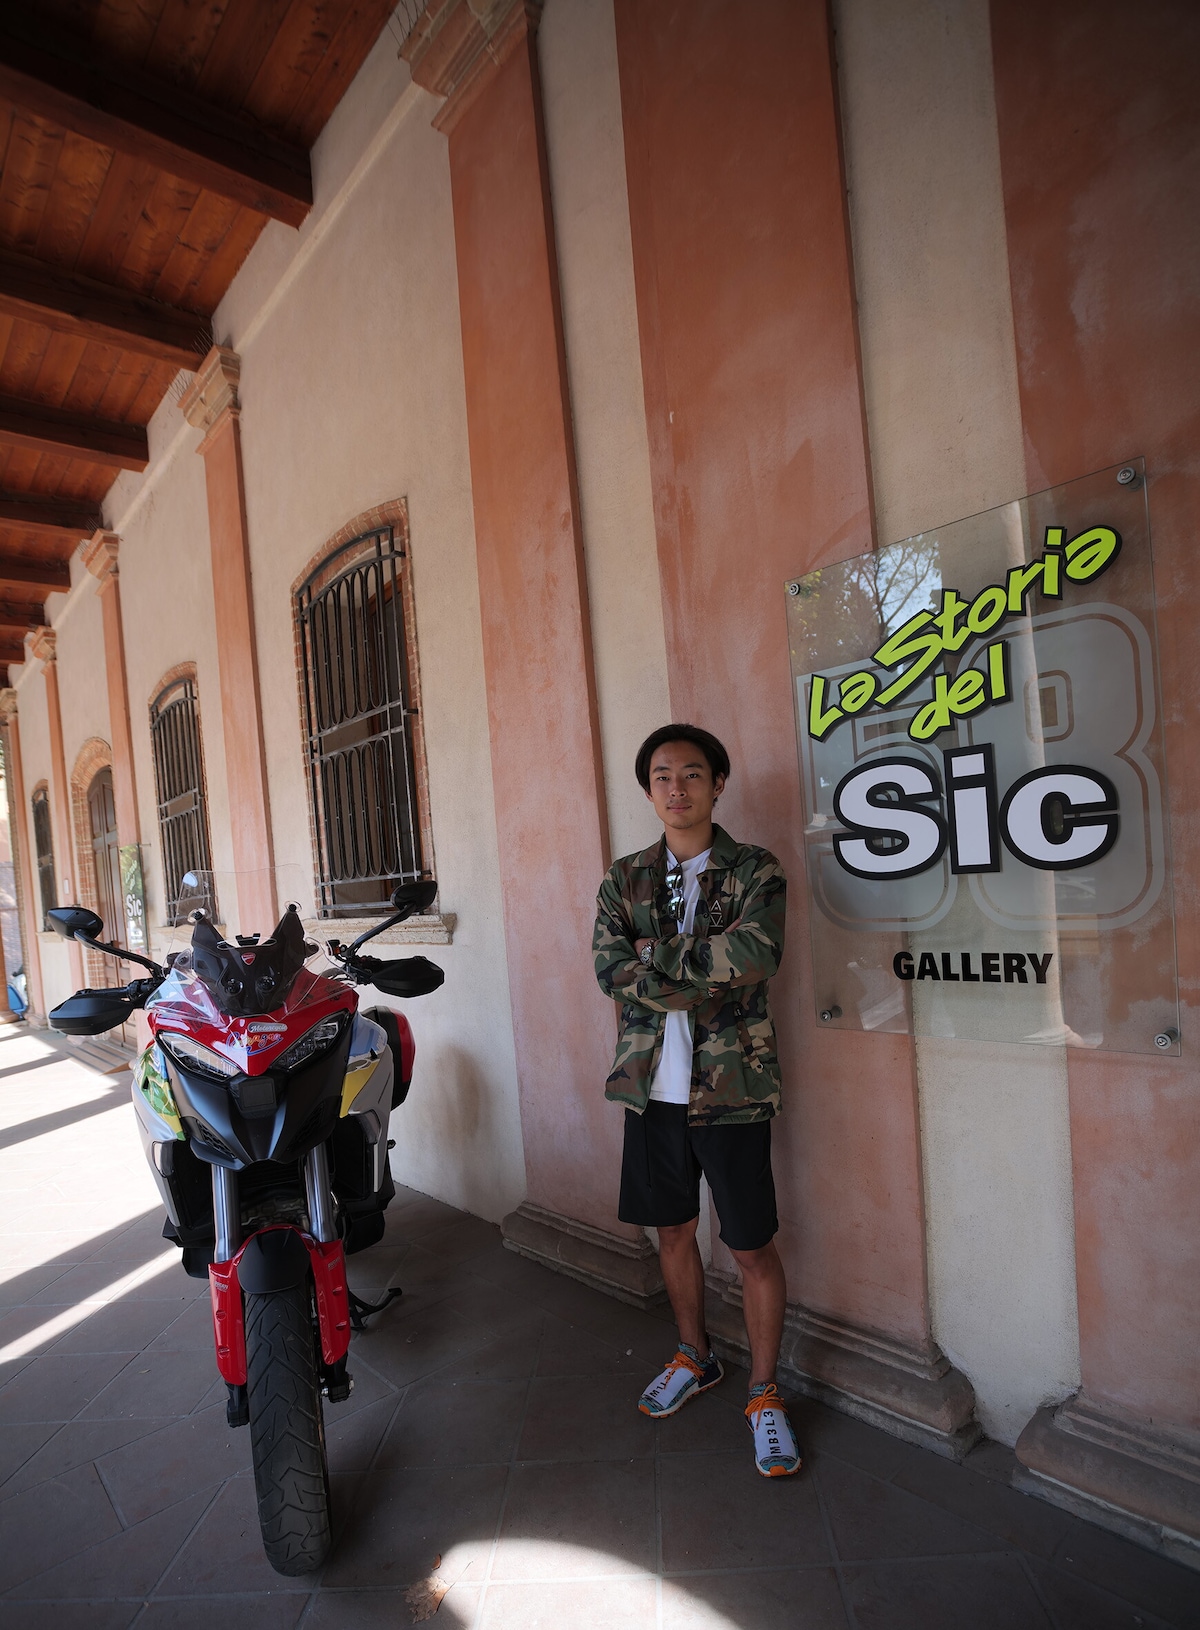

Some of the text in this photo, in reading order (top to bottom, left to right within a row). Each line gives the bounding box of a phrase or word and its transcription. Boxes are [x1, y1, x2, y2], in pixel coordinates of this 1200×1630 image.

[808, 524, 1122, 742] La Storia
[908, 641, 1012, 743] del
[832, 743, 1119, 880] Sic
[126, 893, 143, 917] Sic
[893, 951, 1053, 984] GALLERY
[763, 1410, 782, 1455] MB3L3
